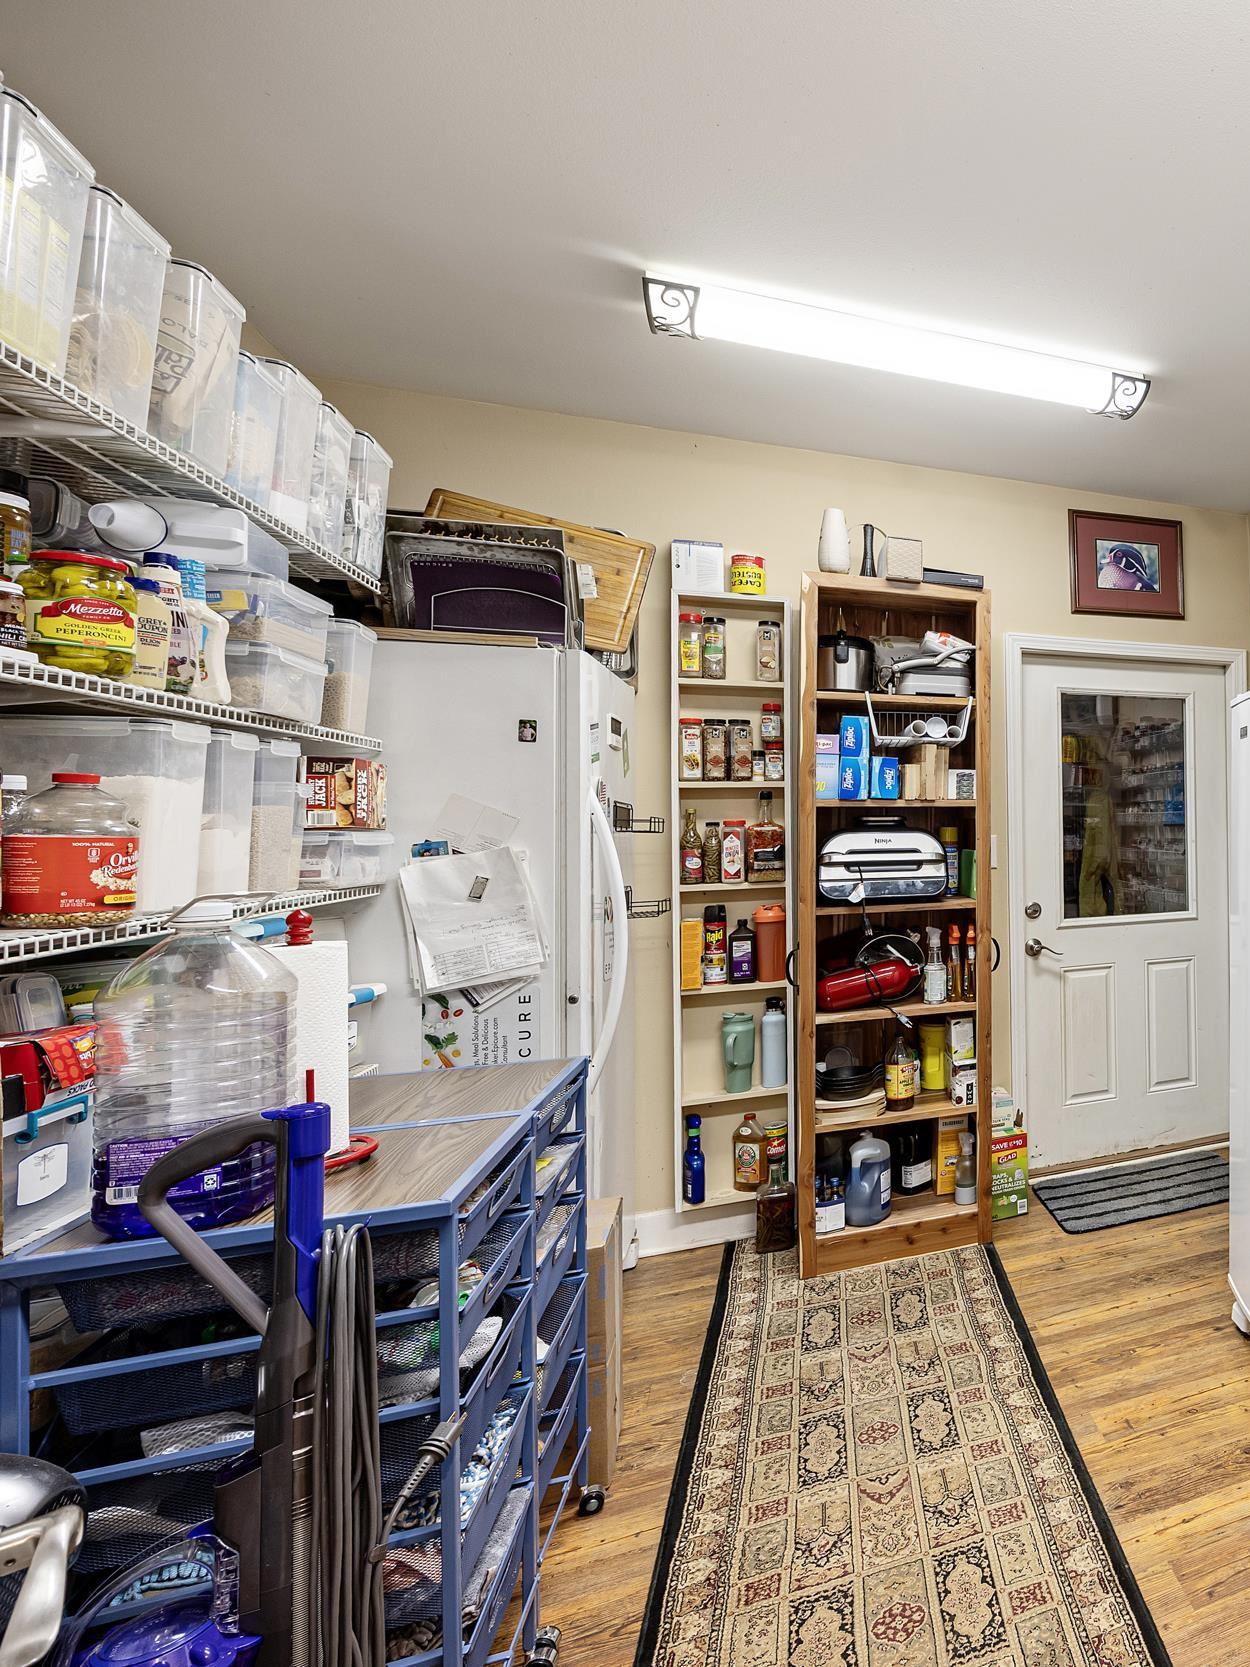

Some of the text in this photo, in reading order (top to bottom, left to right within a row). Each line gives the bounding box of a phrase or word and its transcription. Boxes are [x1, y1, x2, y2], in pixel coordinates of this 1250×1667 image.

[62, 603, 125, 618] Mezzetta
[64, 622, 97, 631] GOLDEN
[138, 616, 162, 626] GREY
[0, 631, 16, 640] HILI
[55, 627, 126, 642] PEPERONCINI
[140, 637, 161, 645] DIJON
[844, 726, 856, 750] Ziploc
[842, 767, 854, 791] Ziploc
[884, 767, 896, 790] Ziploc
[315, 778, 327, 807] JACK
[109, 850, 140, 867] Orvil
[706, 930, 723, 942] Raid
[518, 995, 531, 1058] CURE
[68, 1082, 89, 1096] PACKS
[766, 1144, 786, 1155] Comet
[992, 1142, 1009, 1151] SAVE
[999, 1152, 1017, 1163] GLAD
